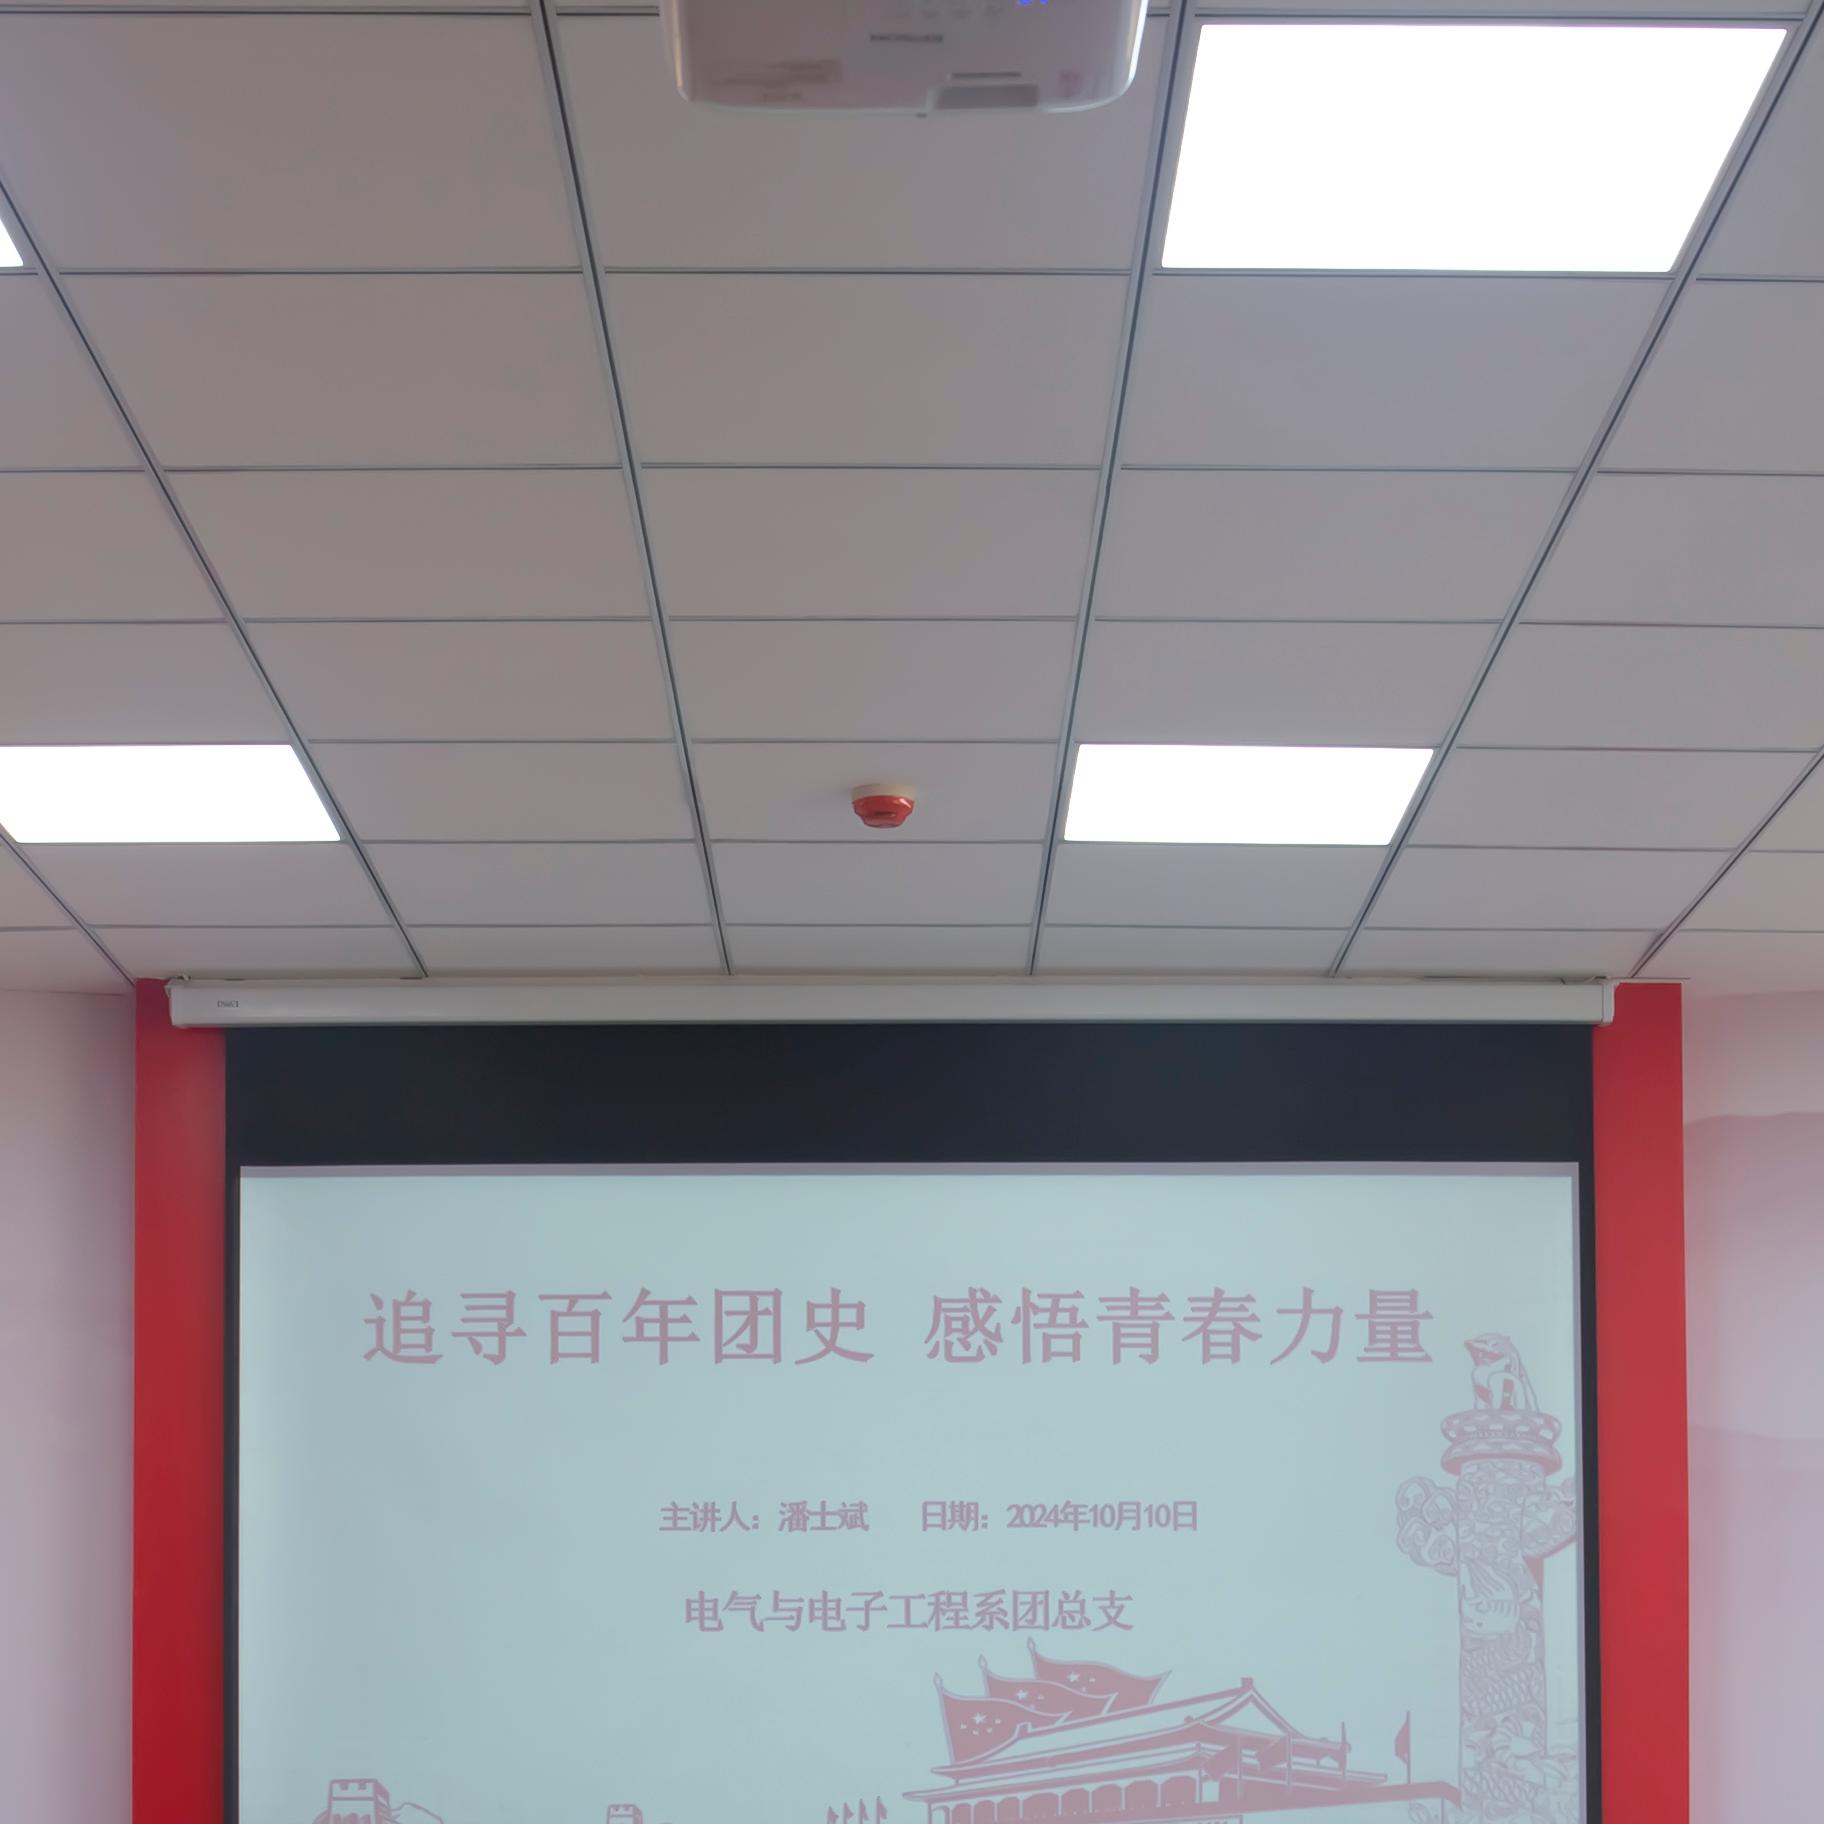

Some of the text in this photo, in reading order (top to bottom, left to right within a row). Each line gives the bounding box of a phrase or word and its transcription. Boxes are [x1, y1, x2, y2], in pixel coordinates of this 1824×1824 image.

[363, 1286, 1434, 1366] 追寻百年团史 感悟青春力量
[684, 1590, 1134, 1633] 电气与电子工程系团总支
